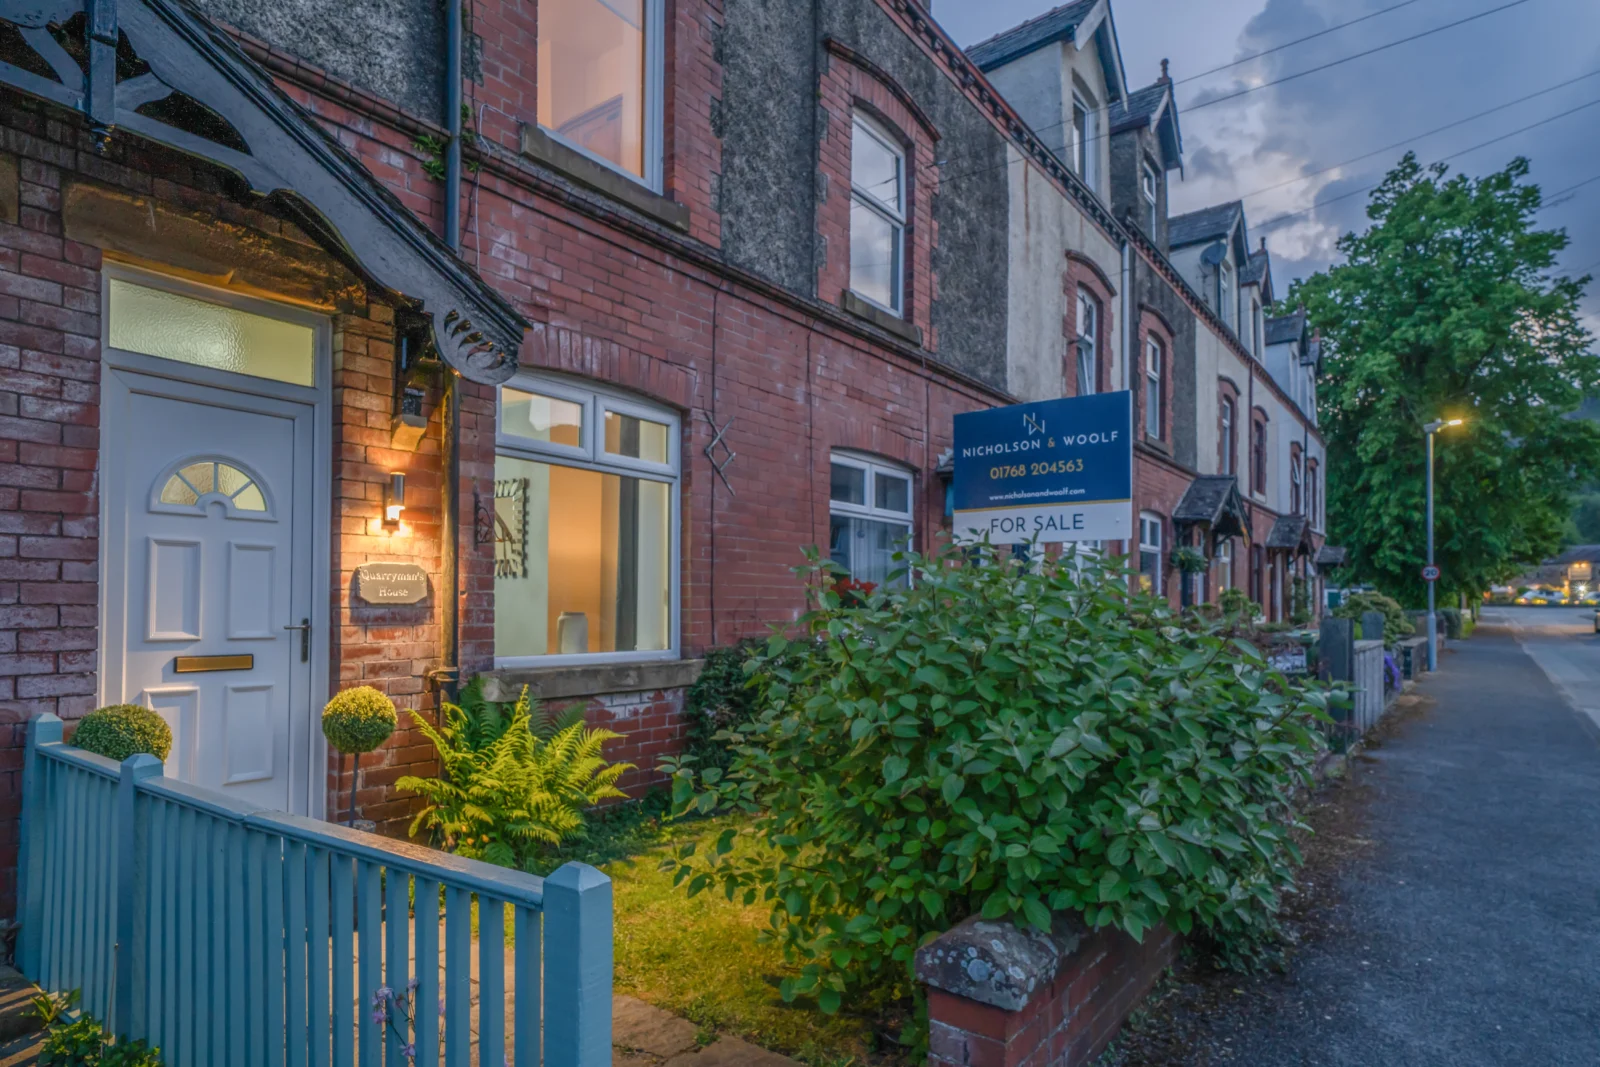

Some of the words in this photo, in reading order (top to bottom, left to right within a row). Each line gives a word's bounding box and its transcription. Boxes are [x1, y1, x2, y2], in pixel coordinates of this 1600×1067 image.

[962, 439, 1041, 458] NICHOLSON
[1047, 437, 1056, 448] &
[1063, 431, 1119, 446] WOOLF
[990, 465, 1026, 480] 01768
[1031, 459, 1084, 476] 204563
[989, 487, 1085, 501] www.nicholsonandwoolf.com
[990, 516, 1026, 534] FOR
[1033, 513, 1085, 531] SALE
[361, 569, 424, 582] Quarryman's
[1424, 568, 1438, 577] 20
[379, 587, 408, 597] House
